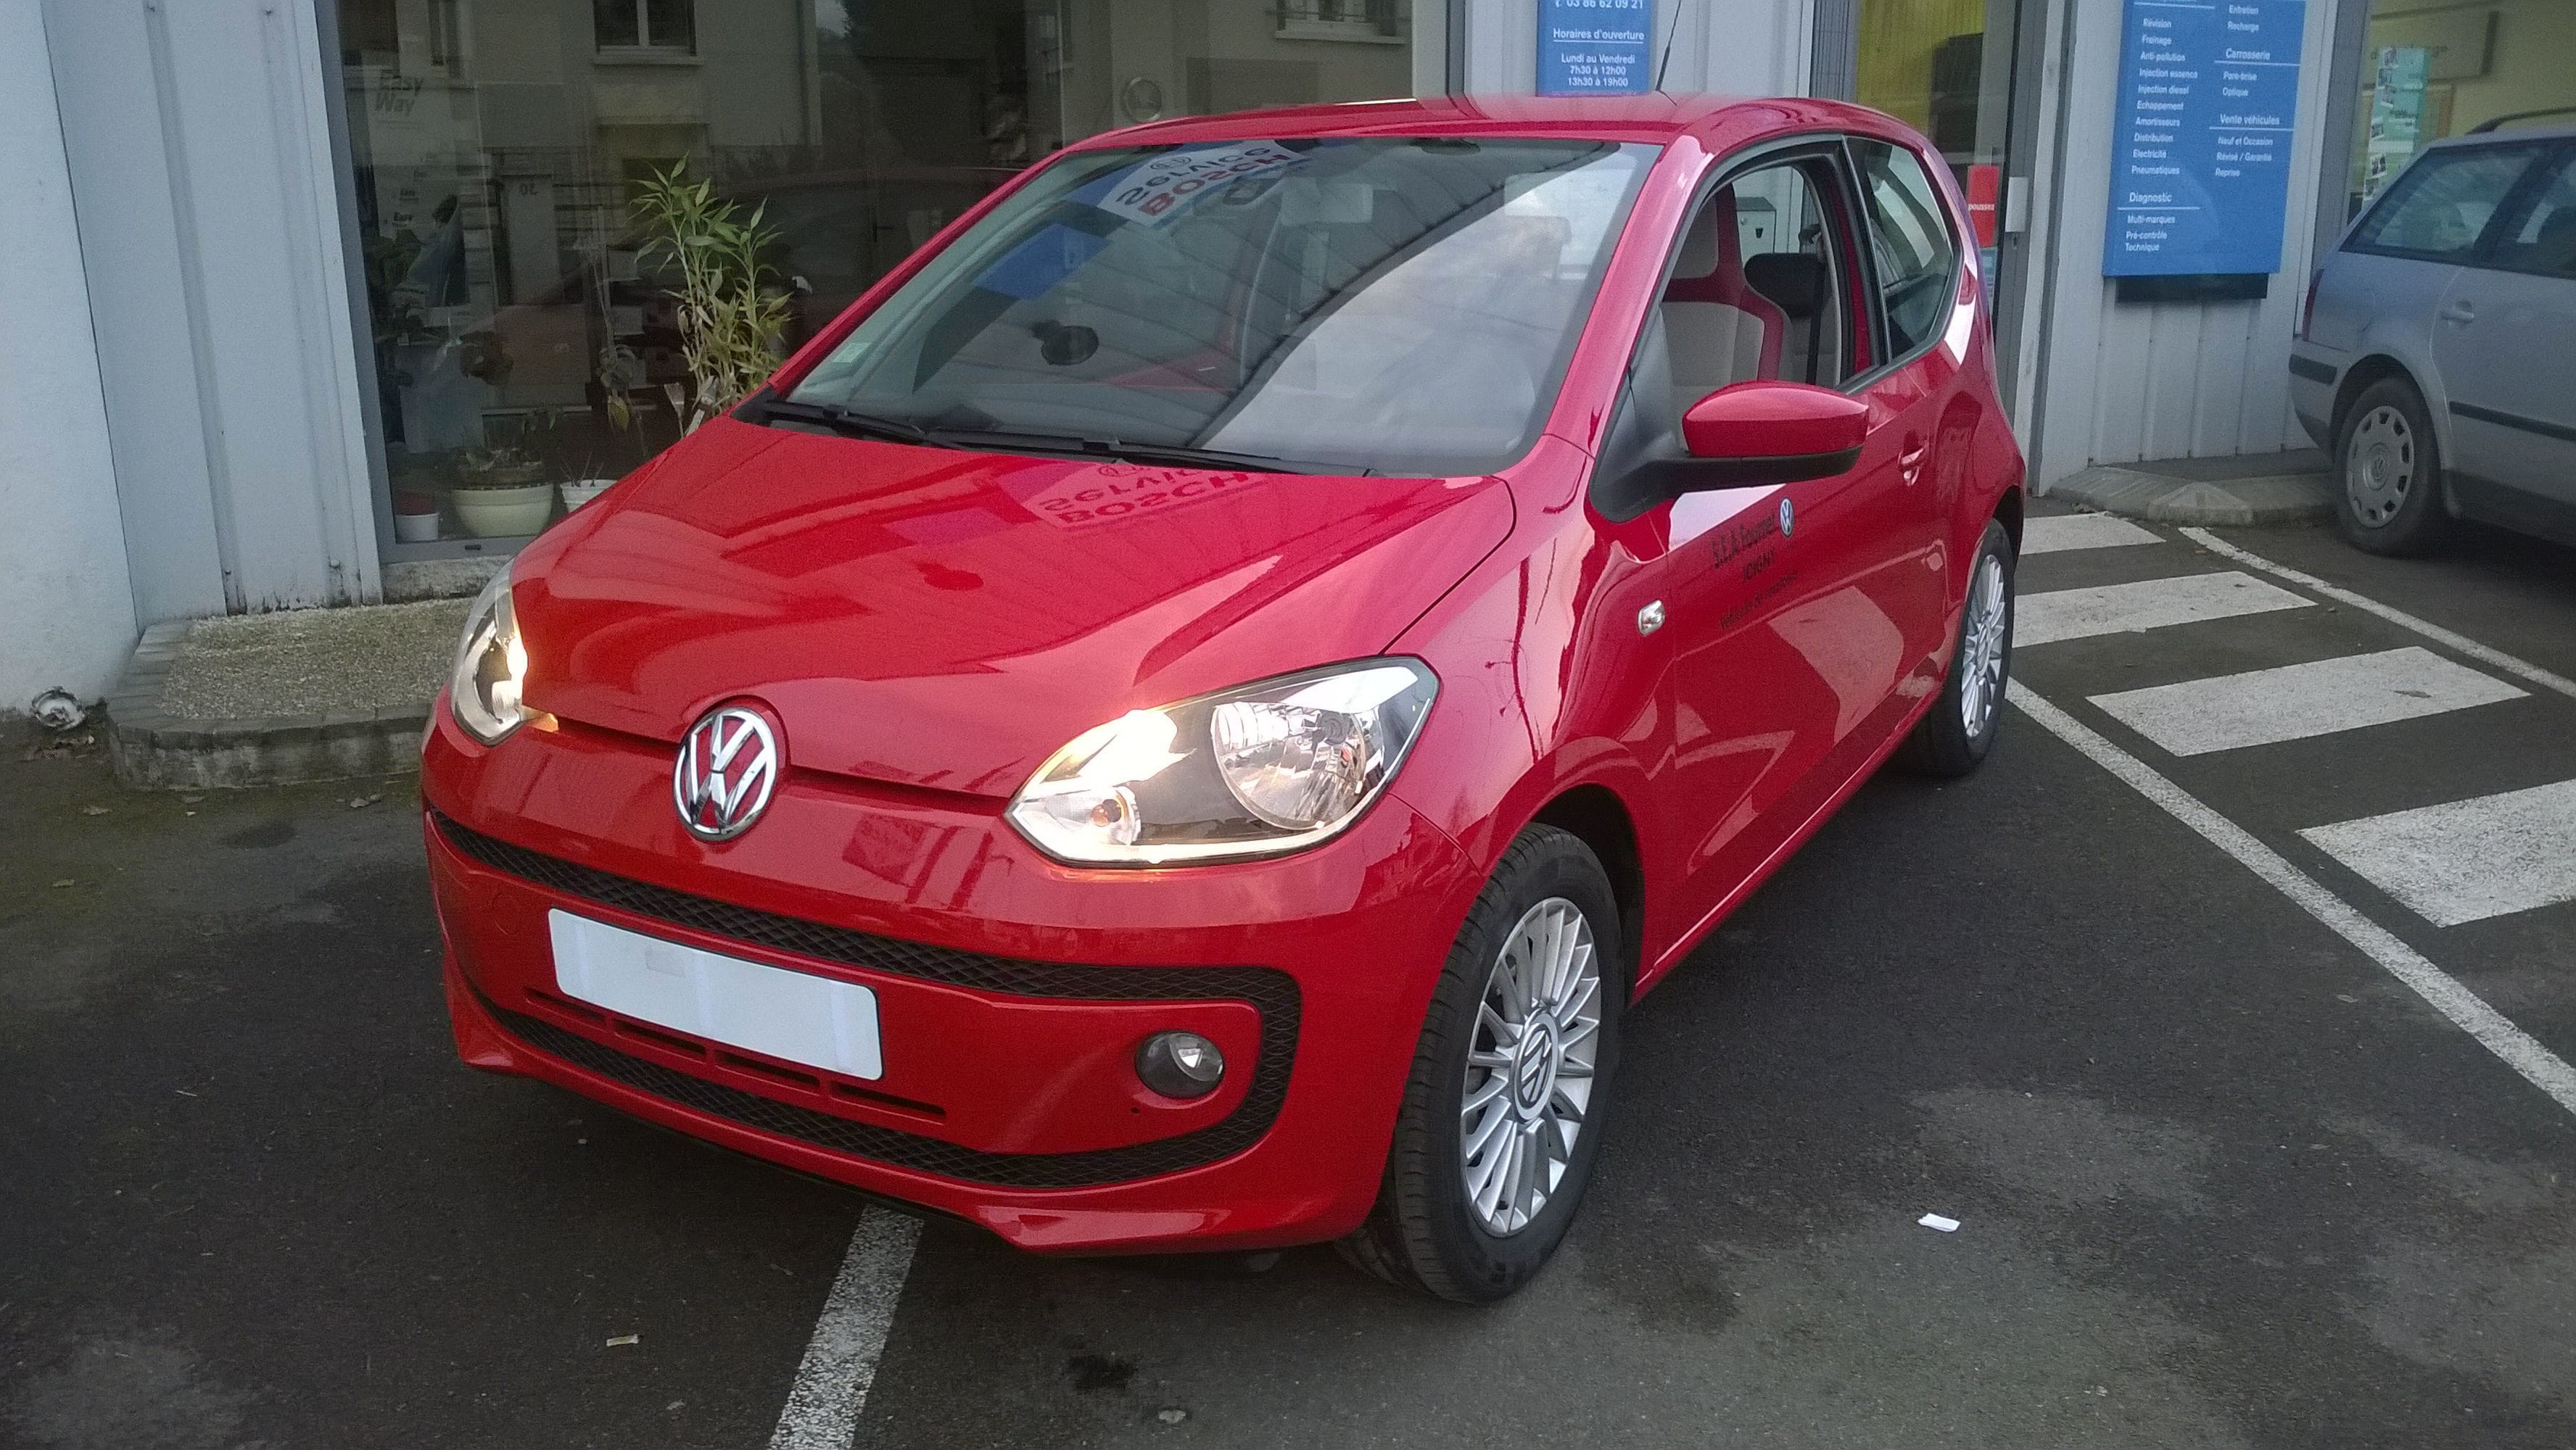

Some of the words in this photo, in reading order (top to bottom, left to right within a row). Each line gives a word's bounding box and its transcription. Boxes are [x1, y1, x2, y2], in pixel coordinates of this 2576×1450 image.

[2229, 4, 2259, 15] Entretien
[2227, 21, 2260, 33] Recharge
[1553, 28, 1591, 40] Horaires
[1593, 29, 1645, 41] d'ouverture
[2142, 35, 2172, 46] Freinage
[1561, 53, 1585, 64] Lundi
[1586, 55, 1597, 64] au
[1599, 54, 1635, 65] Vendredi
[2225, 48, 2271, 60] Carrosserie
[1570, 65, 1591, 75] 7h30
[1593, 65, 1598, 75] à
[1601, 66, 1627, 76] 12h00
[2139, 67, 2168, 78] Injection
[1568, 77, 1593, 86] 13h30
[1595, 77, 1601, 86] à
[1603, 78, 1629, 88] 19h00
[2138, 84, 2167, 95] Injection
[2135, 117, 2181, 127] Amortisseurs
[2220, 114, 2242, 125] Vente
[2244, 115, 2280, 125] véhicules
[2134, 133, 2174, 144] Distribution
[2235, 138, 2242, 146] et
[2243, 136, 2274, 146] Occasion
[2131, 165, 2180, 175] Pneumatiques
[2129, 192, 2172, 204] Diagnostic
[2127, 215, 2176, 224] Multi-marques
[2126, 231, 2168, 240] Pré-contrôle
[2125, 243, 2160, 252] Technique
